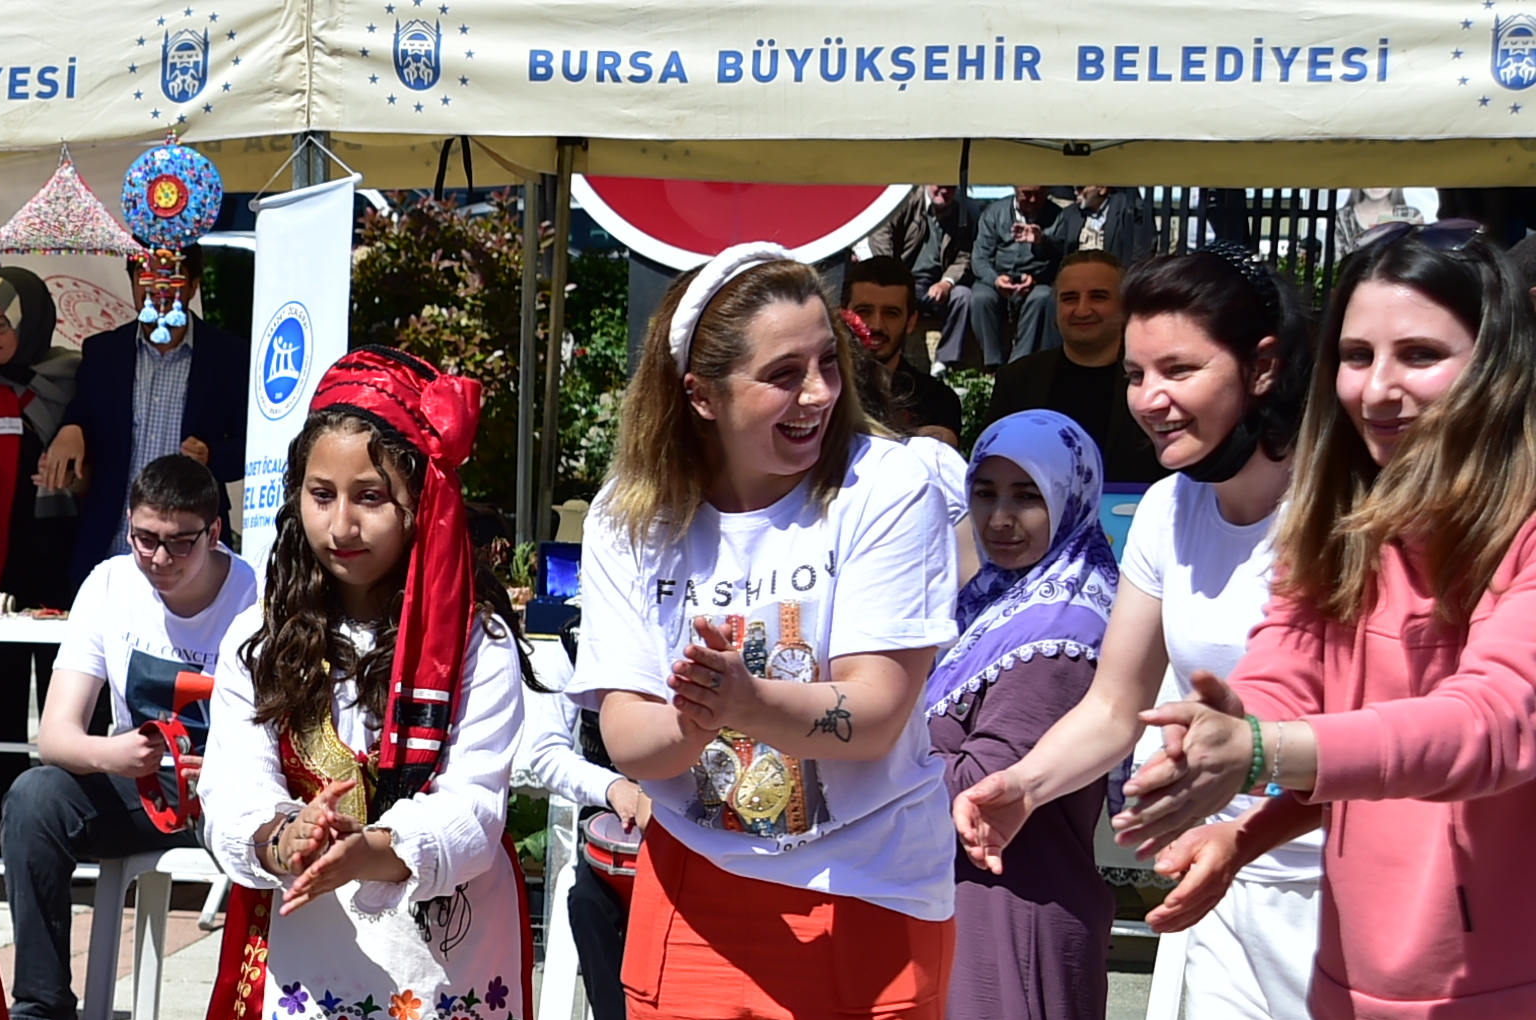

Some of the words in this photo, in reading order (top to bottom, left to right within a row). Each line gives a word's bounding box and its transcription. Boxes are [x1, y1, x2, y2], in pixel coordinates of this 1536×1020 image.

[528, 48, 689, 84] BURSA
[717, 36, 1043, 91] BÜYÜKŞEHİR
[1077, 37, 1390, 83] BELEDİYESİ
